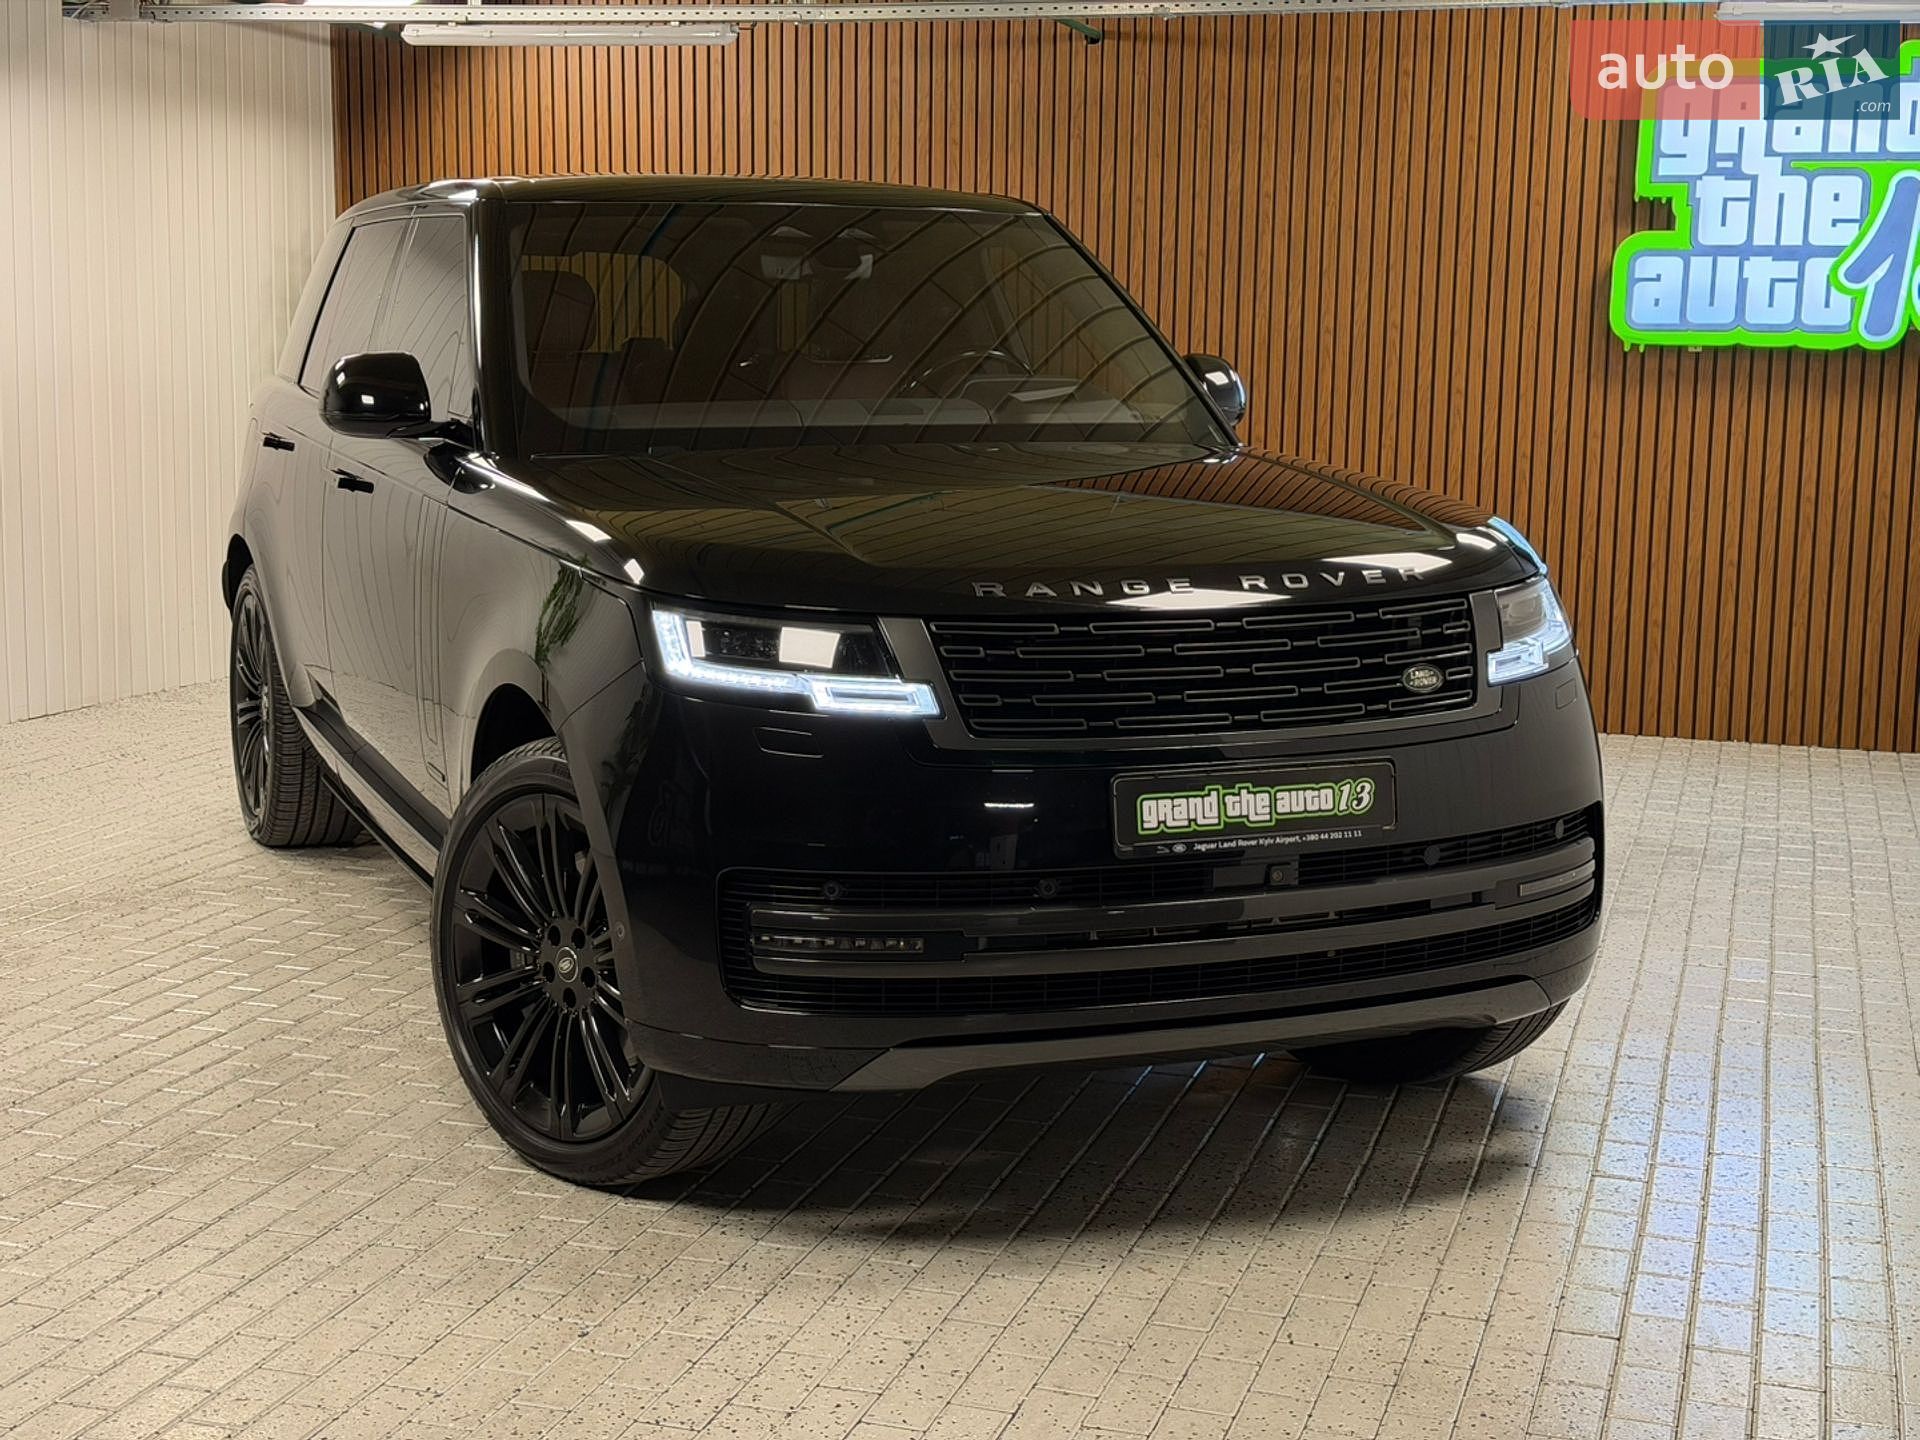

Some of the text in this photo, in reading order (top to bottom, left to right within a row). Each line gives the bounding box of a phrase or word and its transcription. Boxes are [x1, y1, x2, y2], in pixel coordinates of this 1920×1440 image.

[1696, 156, 1864, 246] the
[1631, 170, 1920, 342] auto 1
[971, 568, 1425, 598] RANGE ROVER
[1142, 782, 1372, 829] grand the auto 13
[1193, 842, 1217, 852] Jaguar
[1218, 840, 1237, 848] Land
[1238, 839, 1258, 847] Rover
[1320, 832, 1329, 840] 44
[1344, 830, 1352, 838] 11
[1353, 829, 1362, 837] 11
